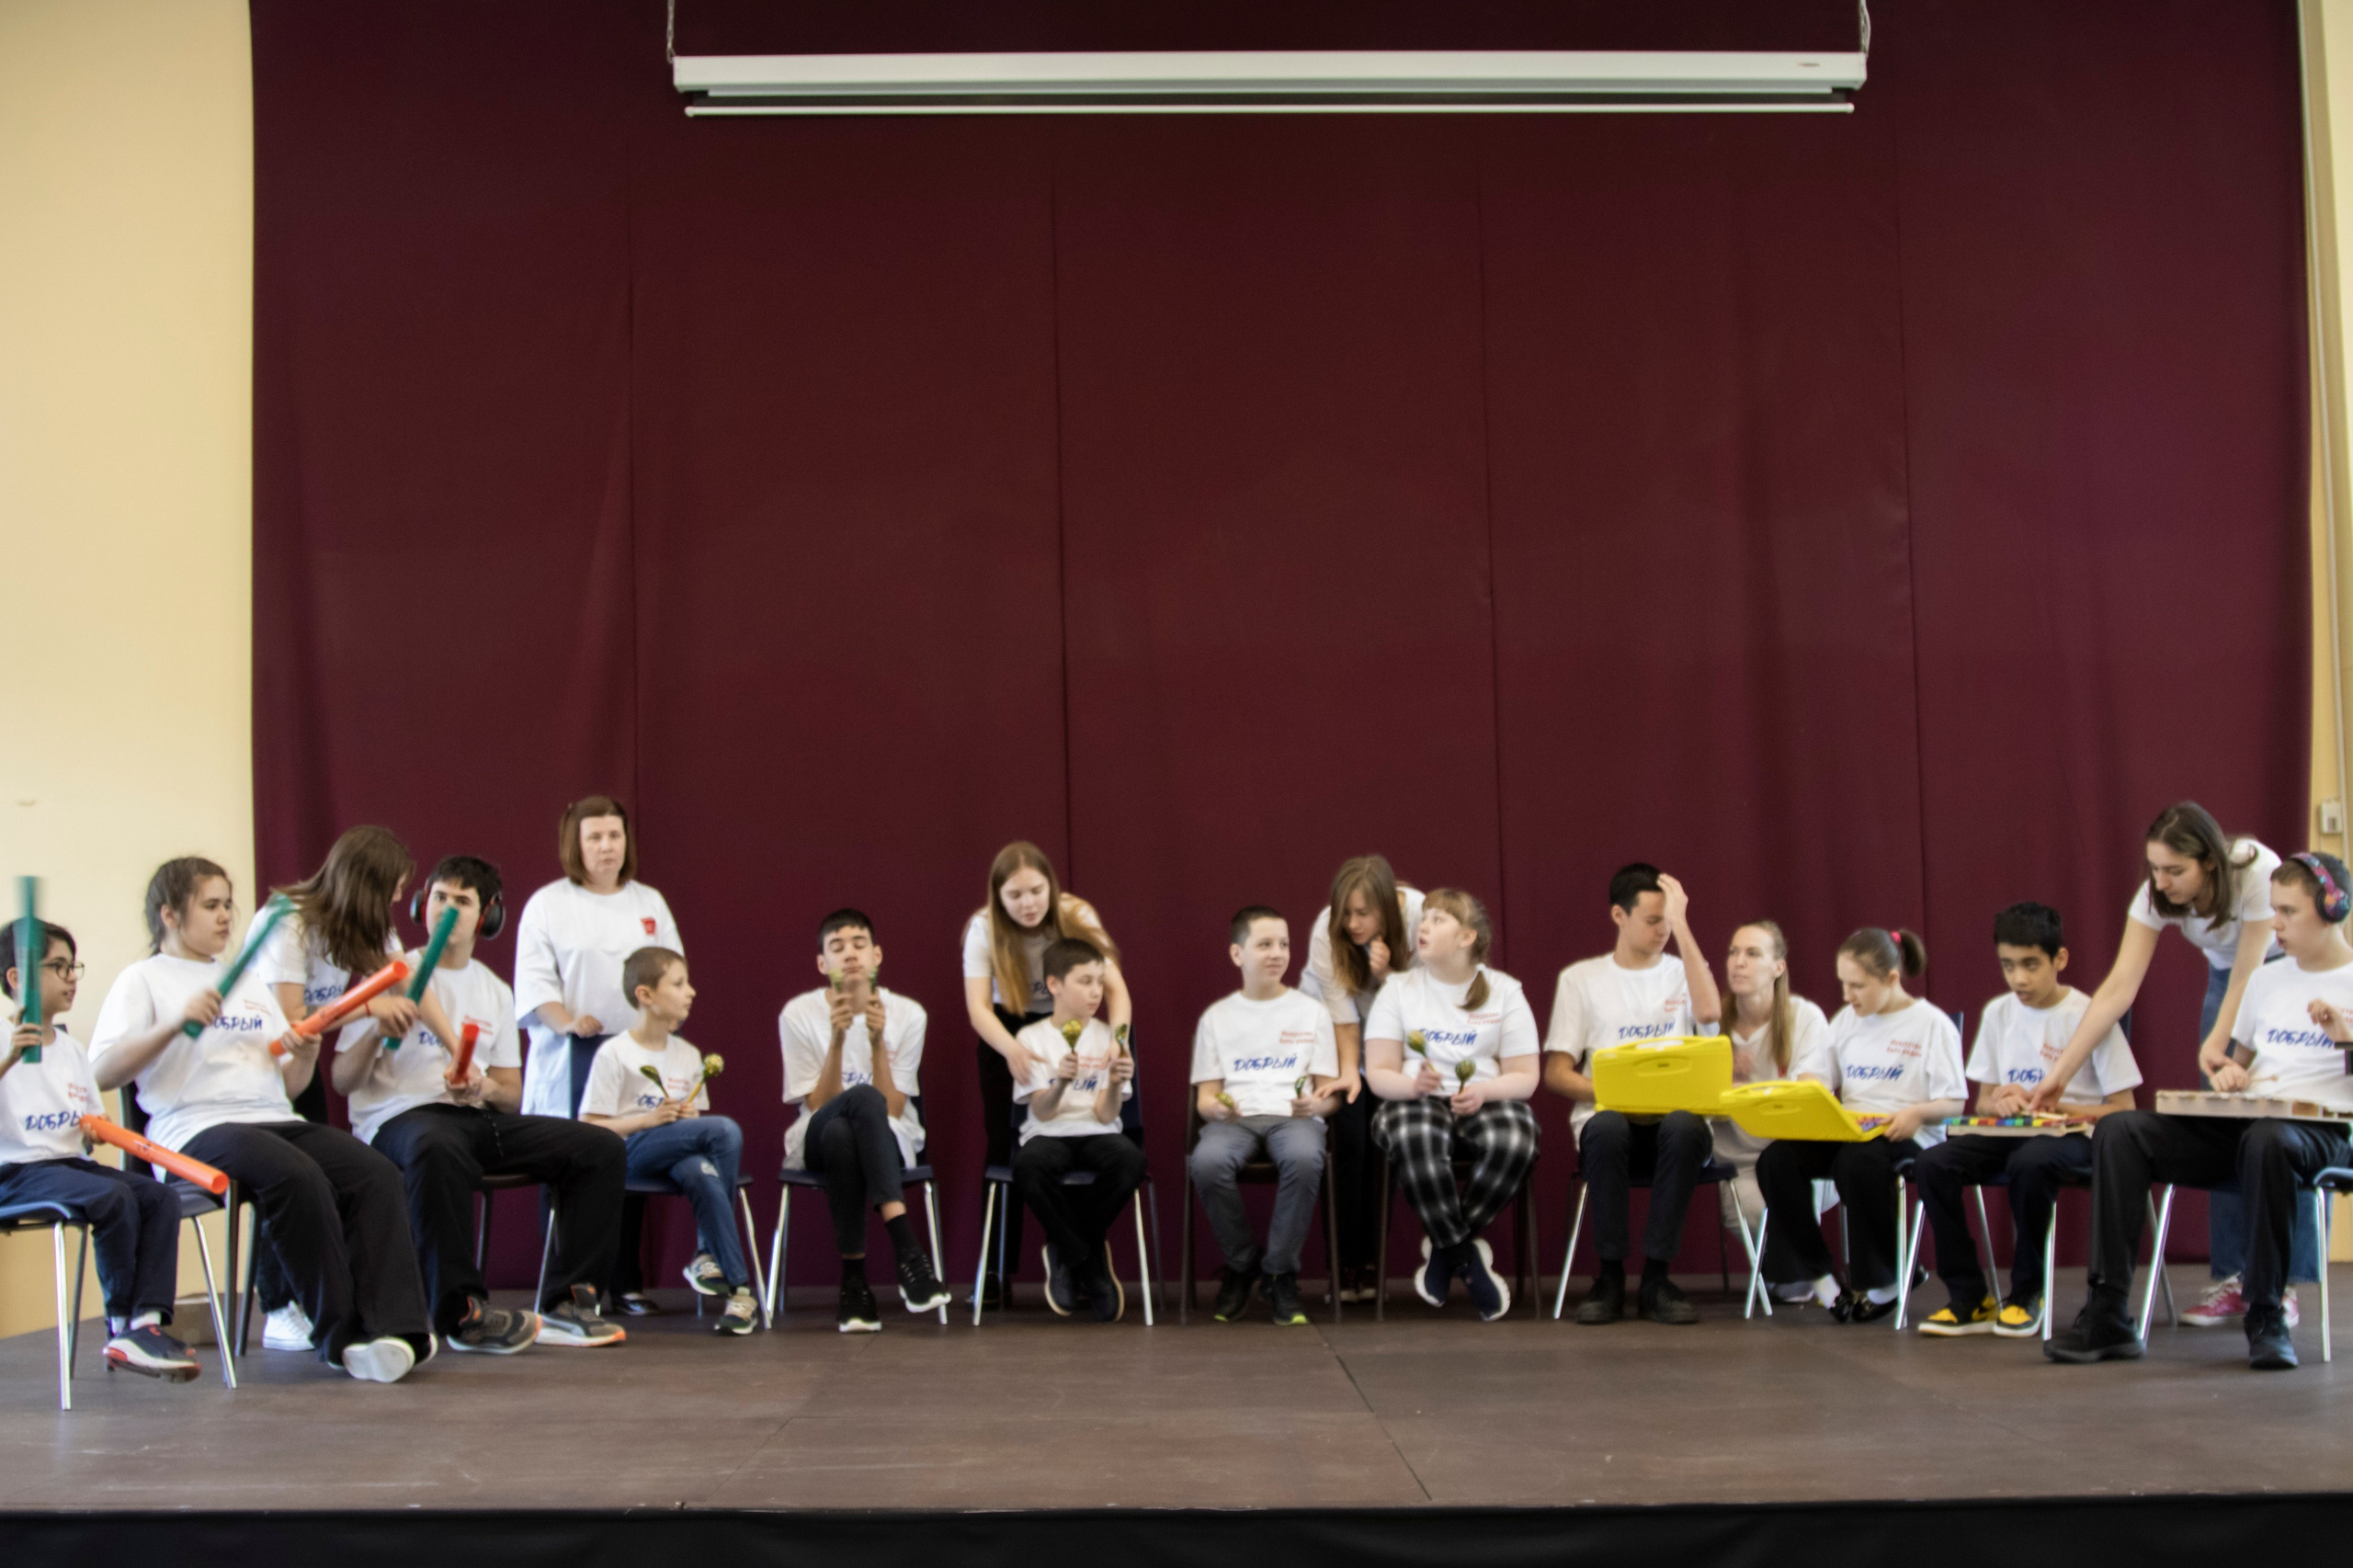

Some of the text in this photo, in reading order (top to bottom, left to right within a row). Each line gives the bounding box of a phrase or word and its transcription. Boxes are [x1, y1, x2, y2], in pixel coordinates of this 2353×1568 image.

[212, 1014, 264, 1031] ОБРЫЙ
[1233, 1052, 1298, 1073] ДОБРЫЙ
[1846, 1063, 1904, 1082] ДОБРЫЙ
[25, 1109, 85, 1131] ДОБРЫ
